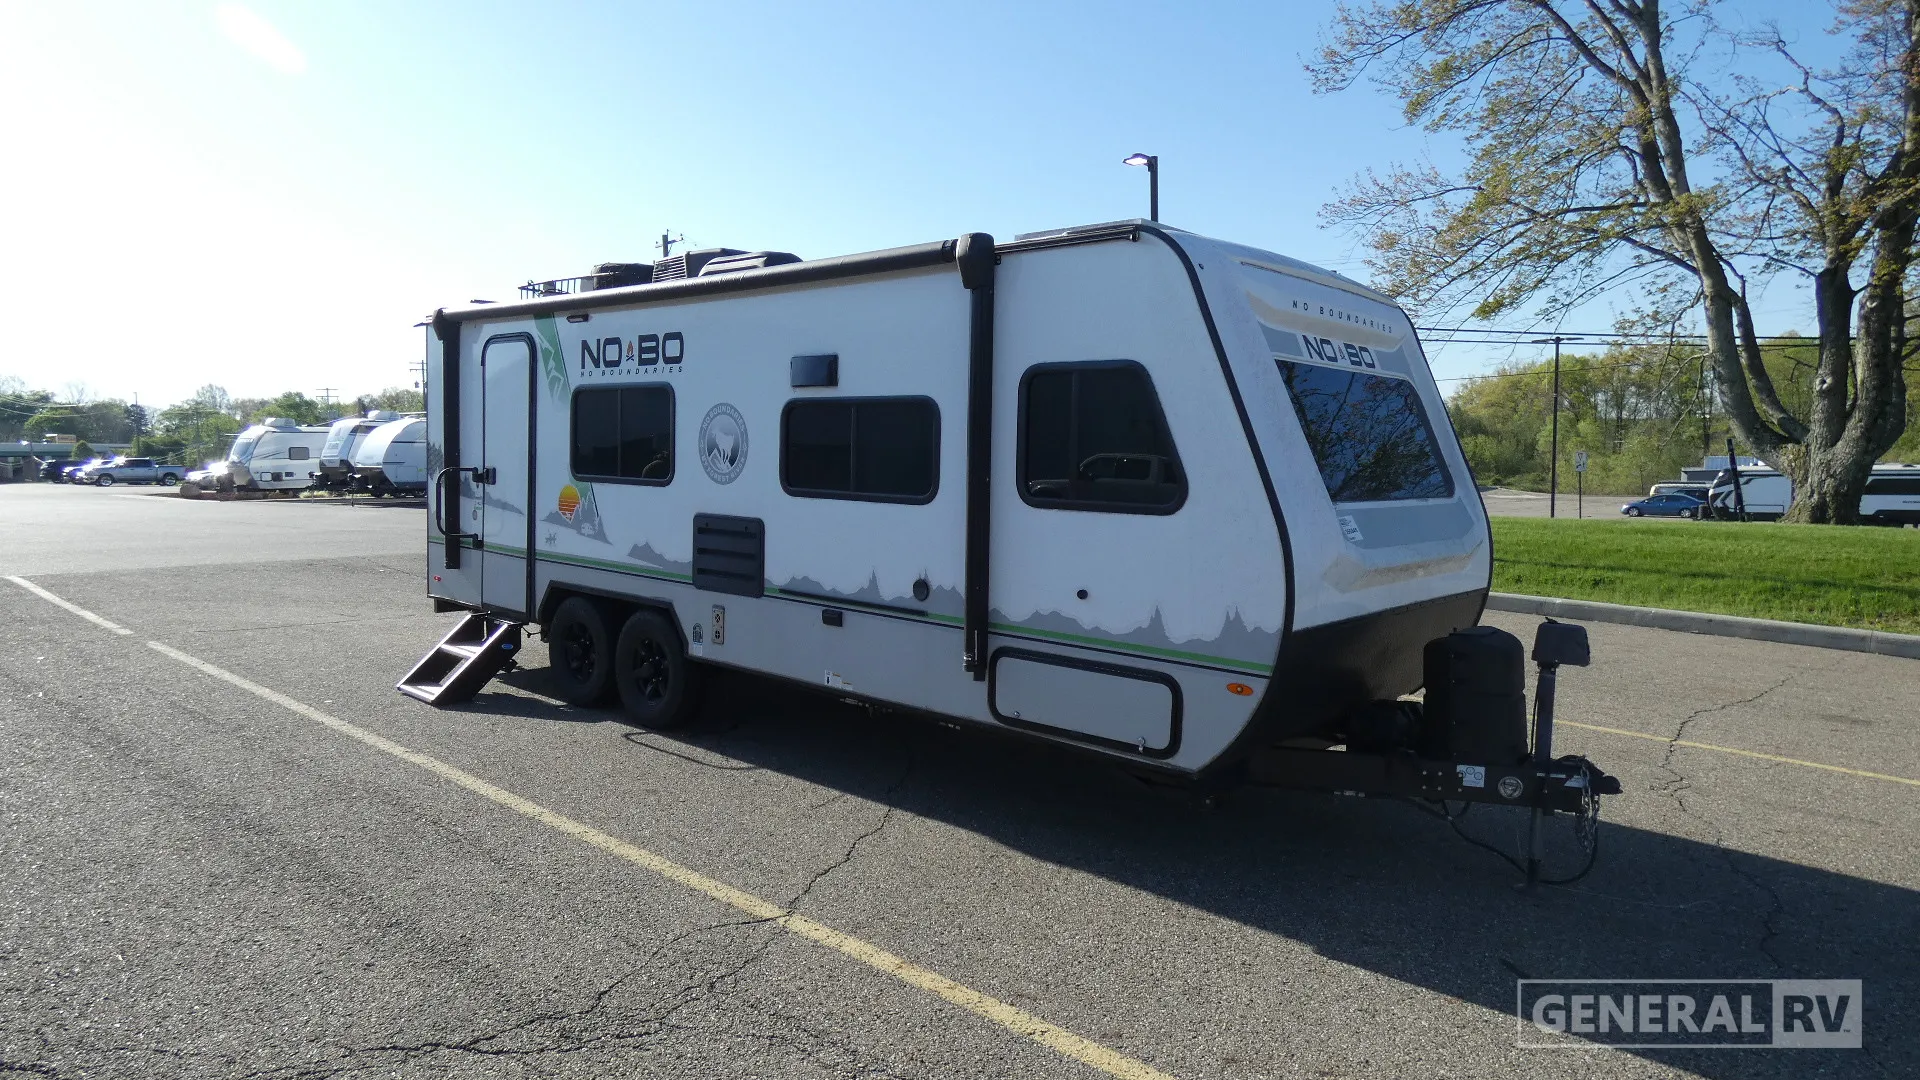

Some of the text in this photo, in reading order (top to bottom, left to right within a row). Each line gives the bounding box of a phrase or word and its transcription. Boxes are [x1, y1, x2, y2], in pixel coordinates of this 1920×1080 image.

[1292, 299, 1393, 334] NO BOUNDARIES
[580, 332, 685, 369] NO BO
[601, 366, 683, 377] BOUNDARIES
[709, 405, 745, 432] BOUNDARIES
[706, 467, 729, 482] FOREST
